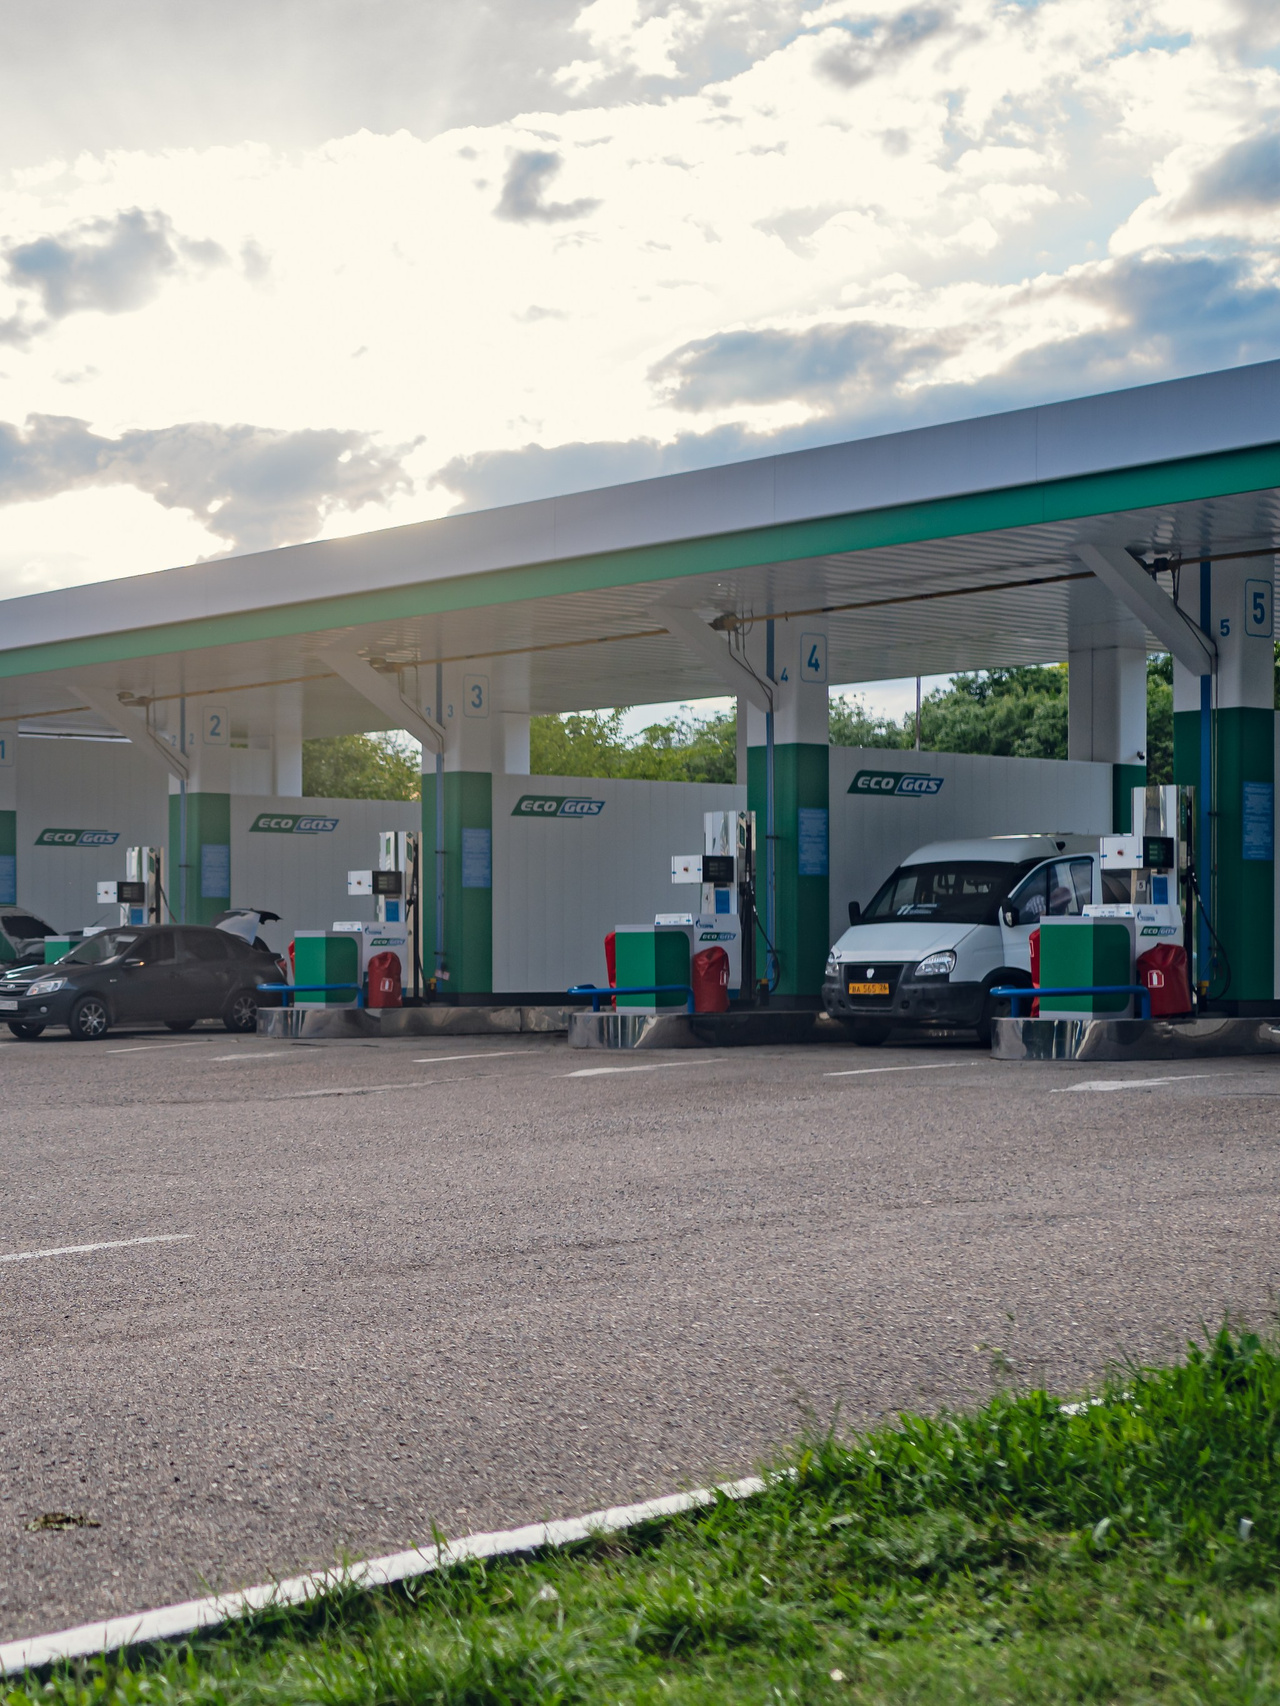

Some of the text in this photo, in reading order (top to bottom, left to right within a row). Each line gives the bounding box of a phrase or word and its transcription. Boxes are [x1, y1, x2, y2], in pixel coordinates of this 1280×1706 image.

[1252, 591, 1266, 625] 5
[1220, 618, 1231, 637] 5
[807, 644, 821, 672] 4
[780, 667, 789, 682] 4
[471, 684, 483, 709] 3
[447, 704, 454, 718] 3
[210, 714, 221, 737] 2
[171, 734, 177, 747] 2
[189, 732, 195, 745] 2
[857, 776, 895, 789] ECO
[520, 800, 557, 812] ECO
[258, 818, 293, 829] ECO
[43, 832, 76, 842] ECO
[1142, 927, 1158, 935] ECO
